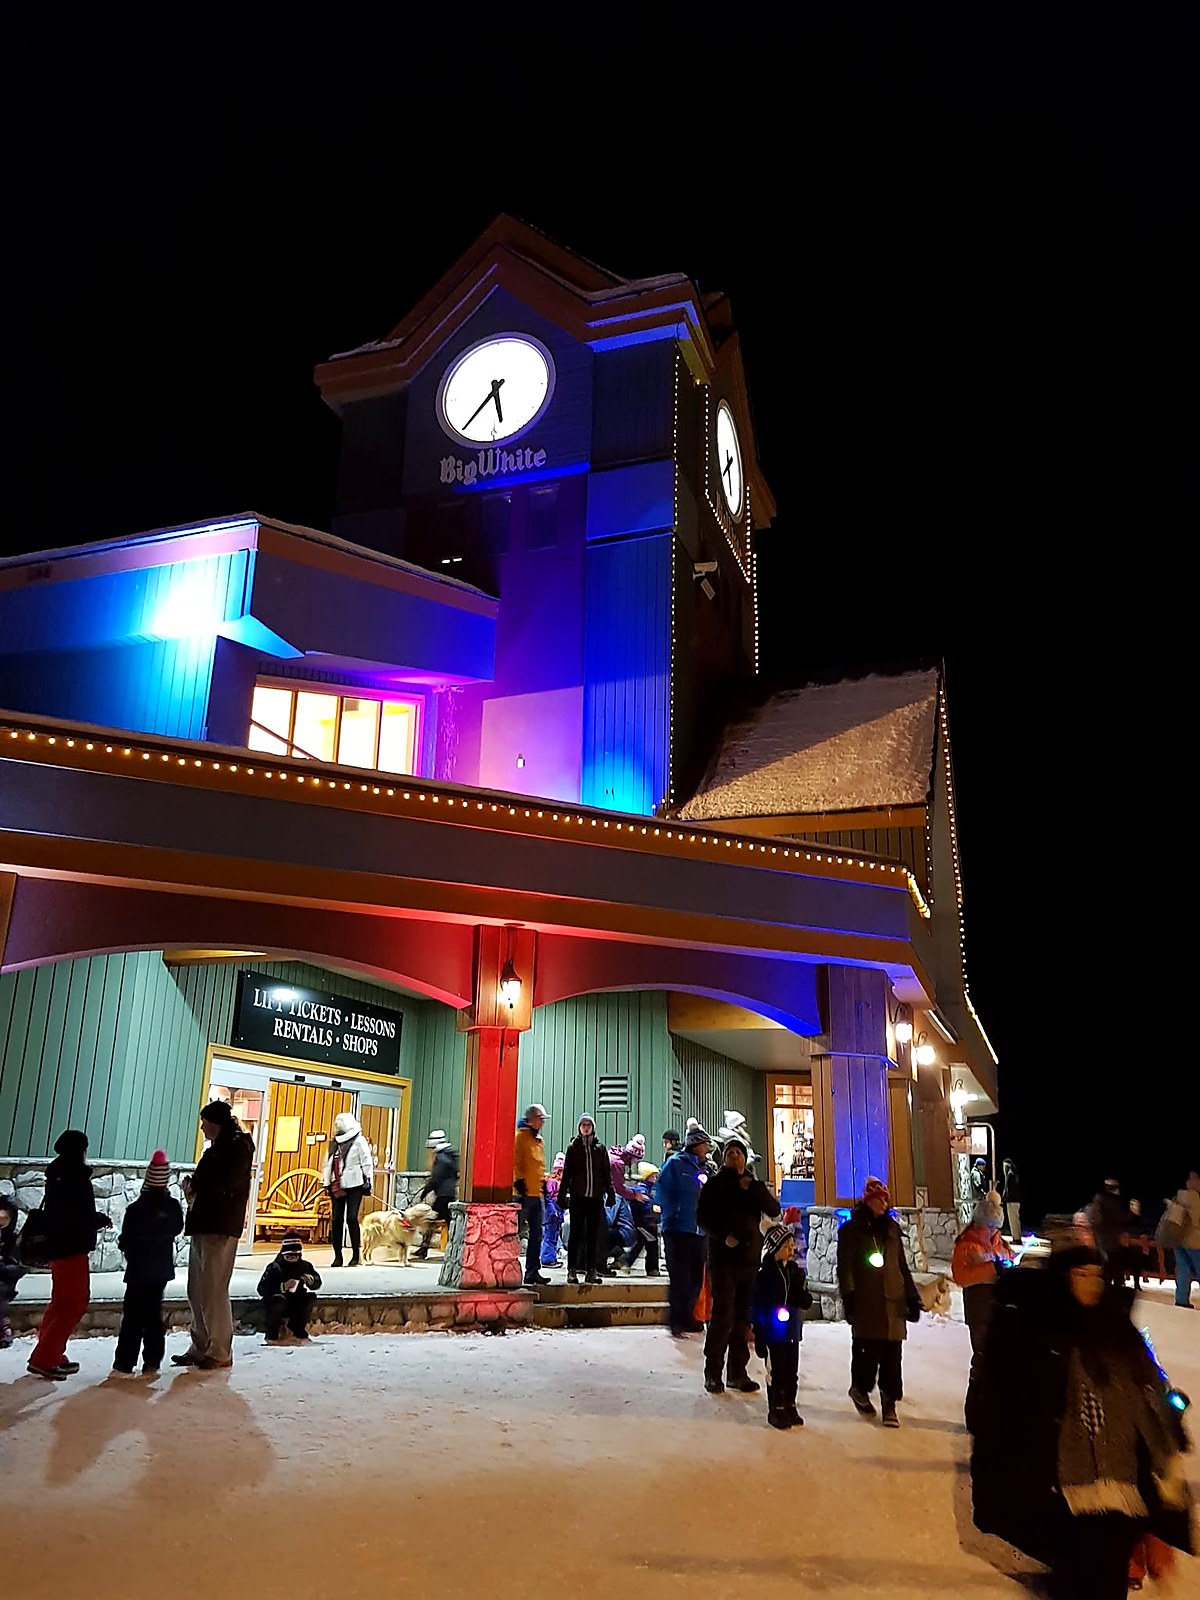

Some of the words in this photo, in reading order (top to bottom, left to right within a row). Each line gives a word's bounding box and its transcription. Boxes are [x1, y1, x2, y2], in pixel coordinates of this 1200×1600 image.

[273, 1018, 333, 1047] RENTALS
[342, 1033, 378, 1057] SHOPS
[289, 998, 342, 1026] TICKETS
[350, 1012, 396, 1039] LESSONS
